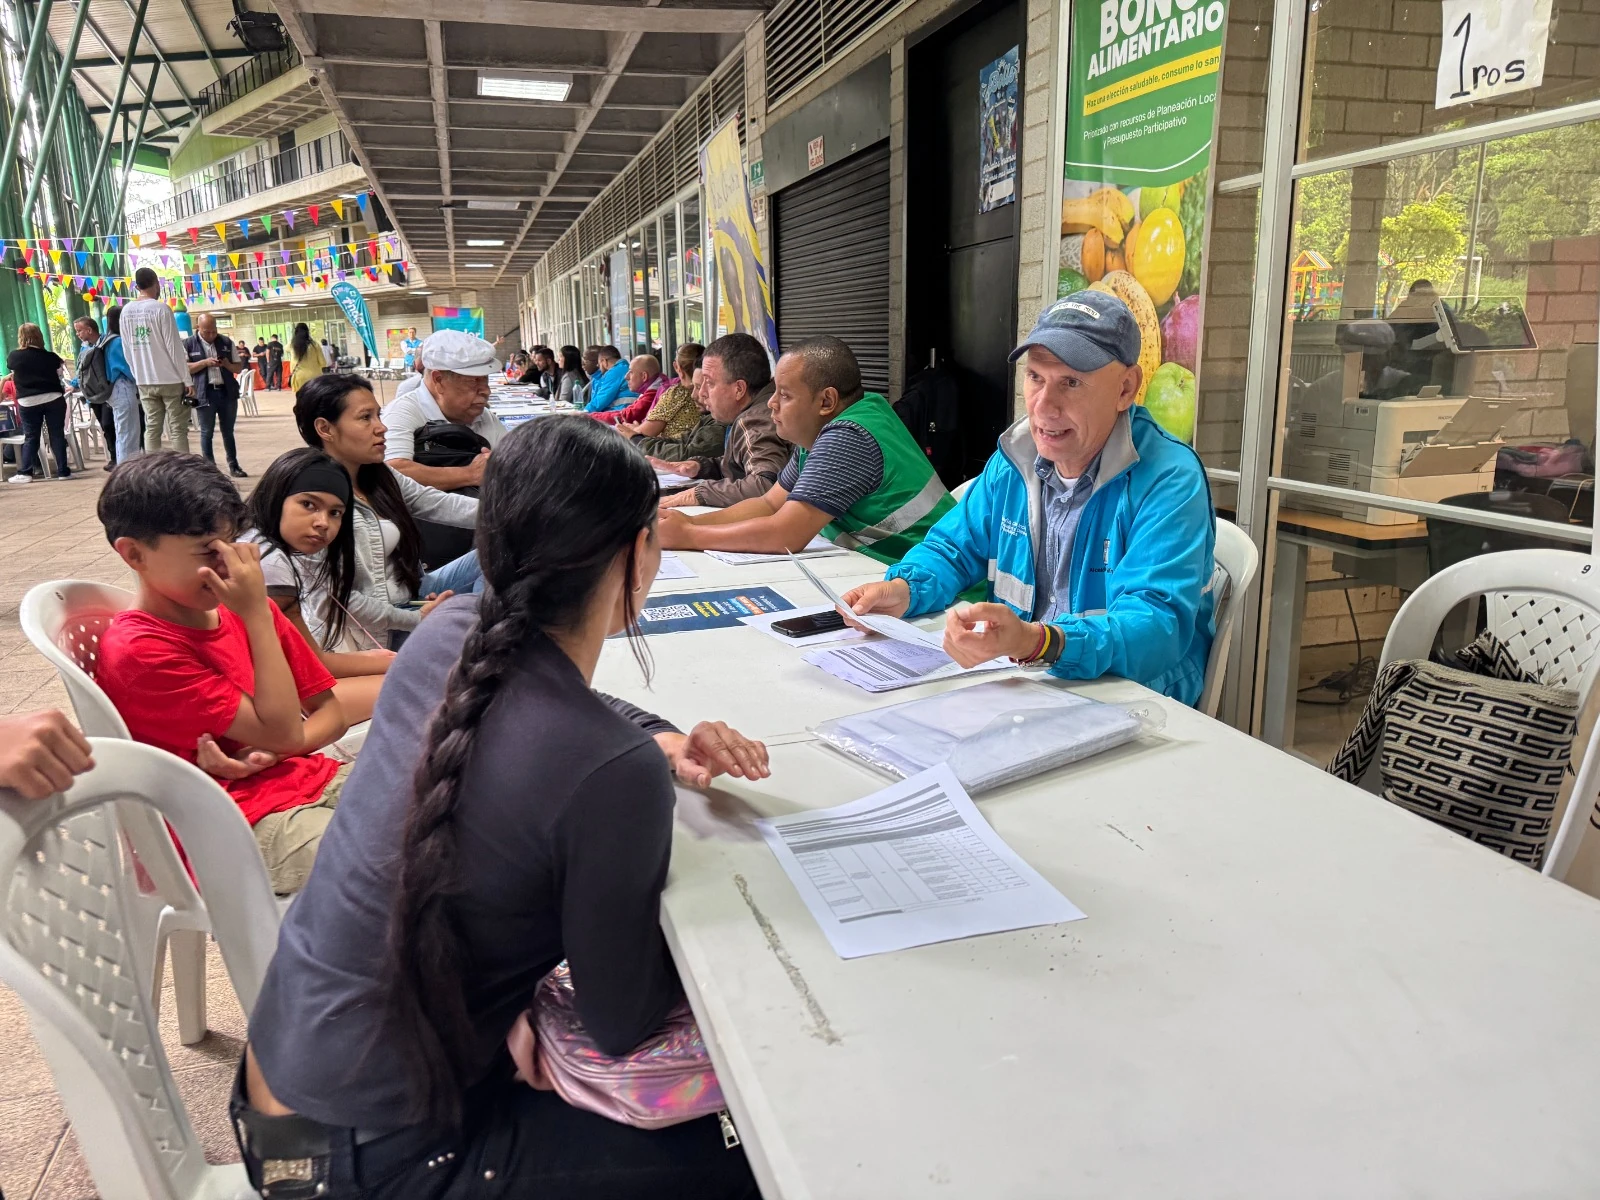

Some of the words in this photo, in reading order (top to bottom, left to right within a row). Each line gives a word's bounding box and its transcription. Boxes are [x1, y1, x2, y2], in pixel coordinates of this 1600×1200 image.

[1087, 1, 1225, 80] ALIMENTARIO
[1099, 0, 1198, 49] BON
[1086, 99, 1096, 109] Haz
[1096, 95, 1106, 105] una
[1106, 86, 1129, 101] elección
[1129, 74, 1161, 92] saludable,
[1161, 63, 1195, 81] consume
[1195, 59, 1203, 70] lo
[1083, 124, 1109, 141] Priorizado
[1109, 121, 1119, 132] con
[1119, 112, 1146, 129] recursos
[1146, 108, 1156, 120] de
[1156, 96, 1197, 117] Planeación
[1102, 139, 1107, 150] y
[1106, 128, 1143, 147] Presupuesto
[1143, 115, 1188, 136] Participativo
